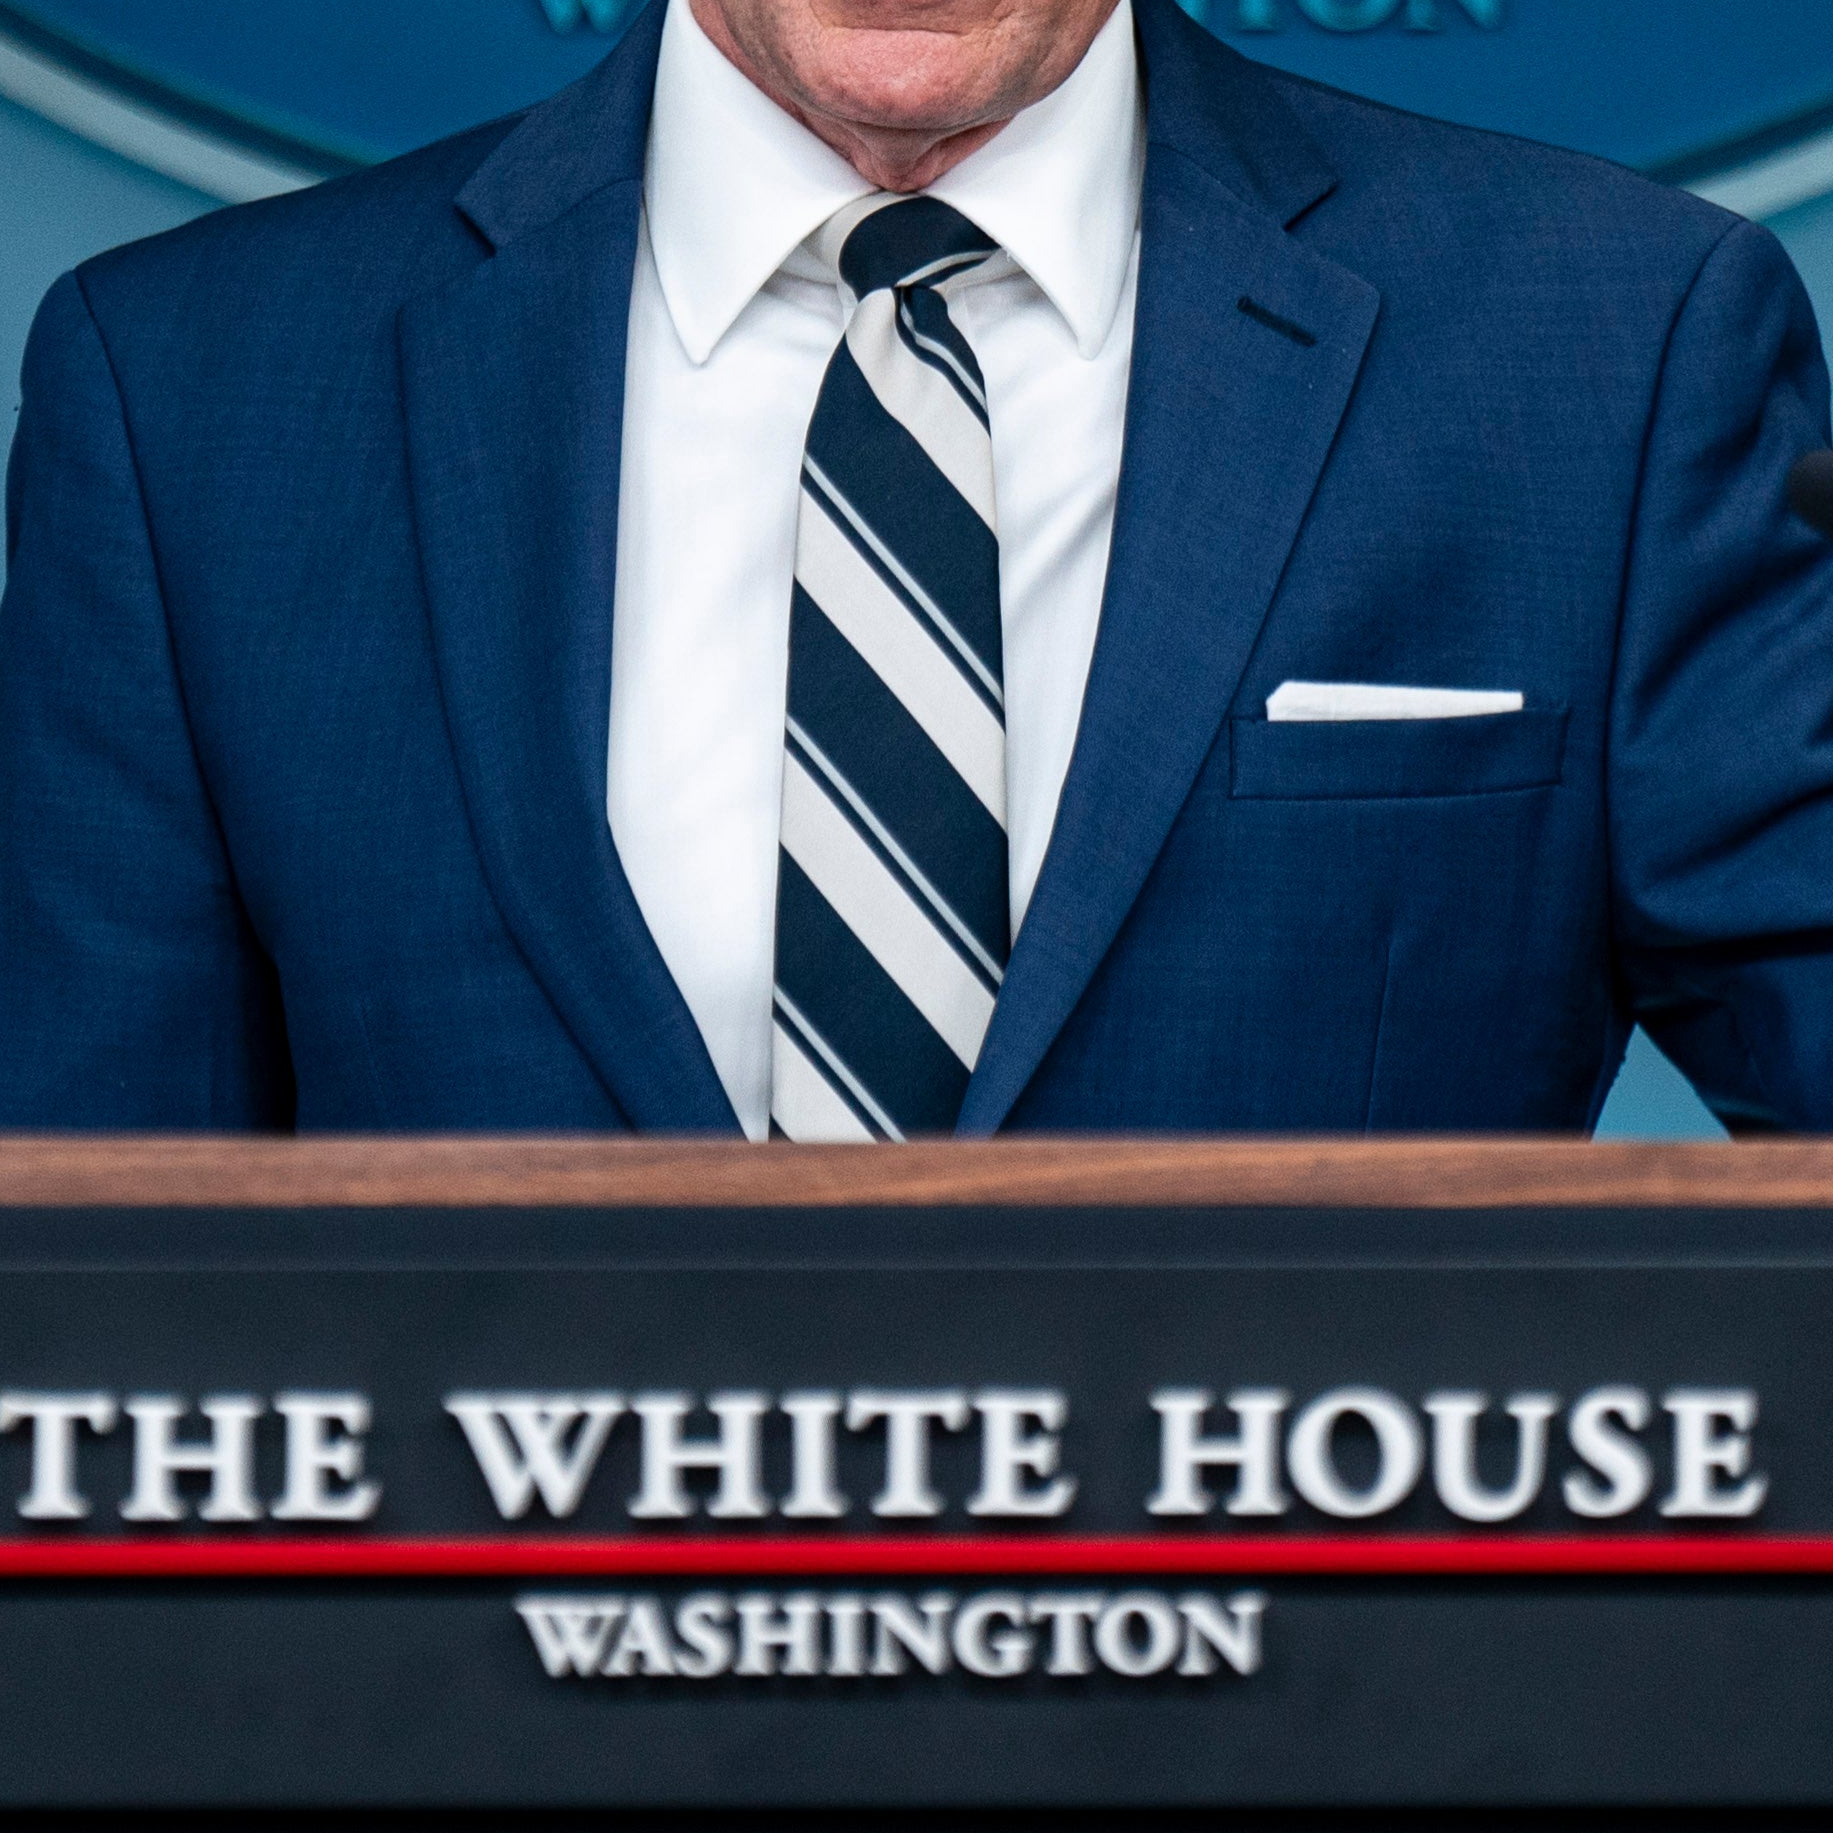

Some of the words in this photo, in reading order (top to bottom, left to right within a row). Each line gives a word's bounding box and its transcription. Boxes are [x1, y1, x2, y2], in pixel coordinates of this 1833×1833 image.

[439, 1386, 1079, 1523] WHITE
[1142, 1384, 1771, 1524] HOUSE
[513, 1589, 1268, 1680] WASHINGTON
